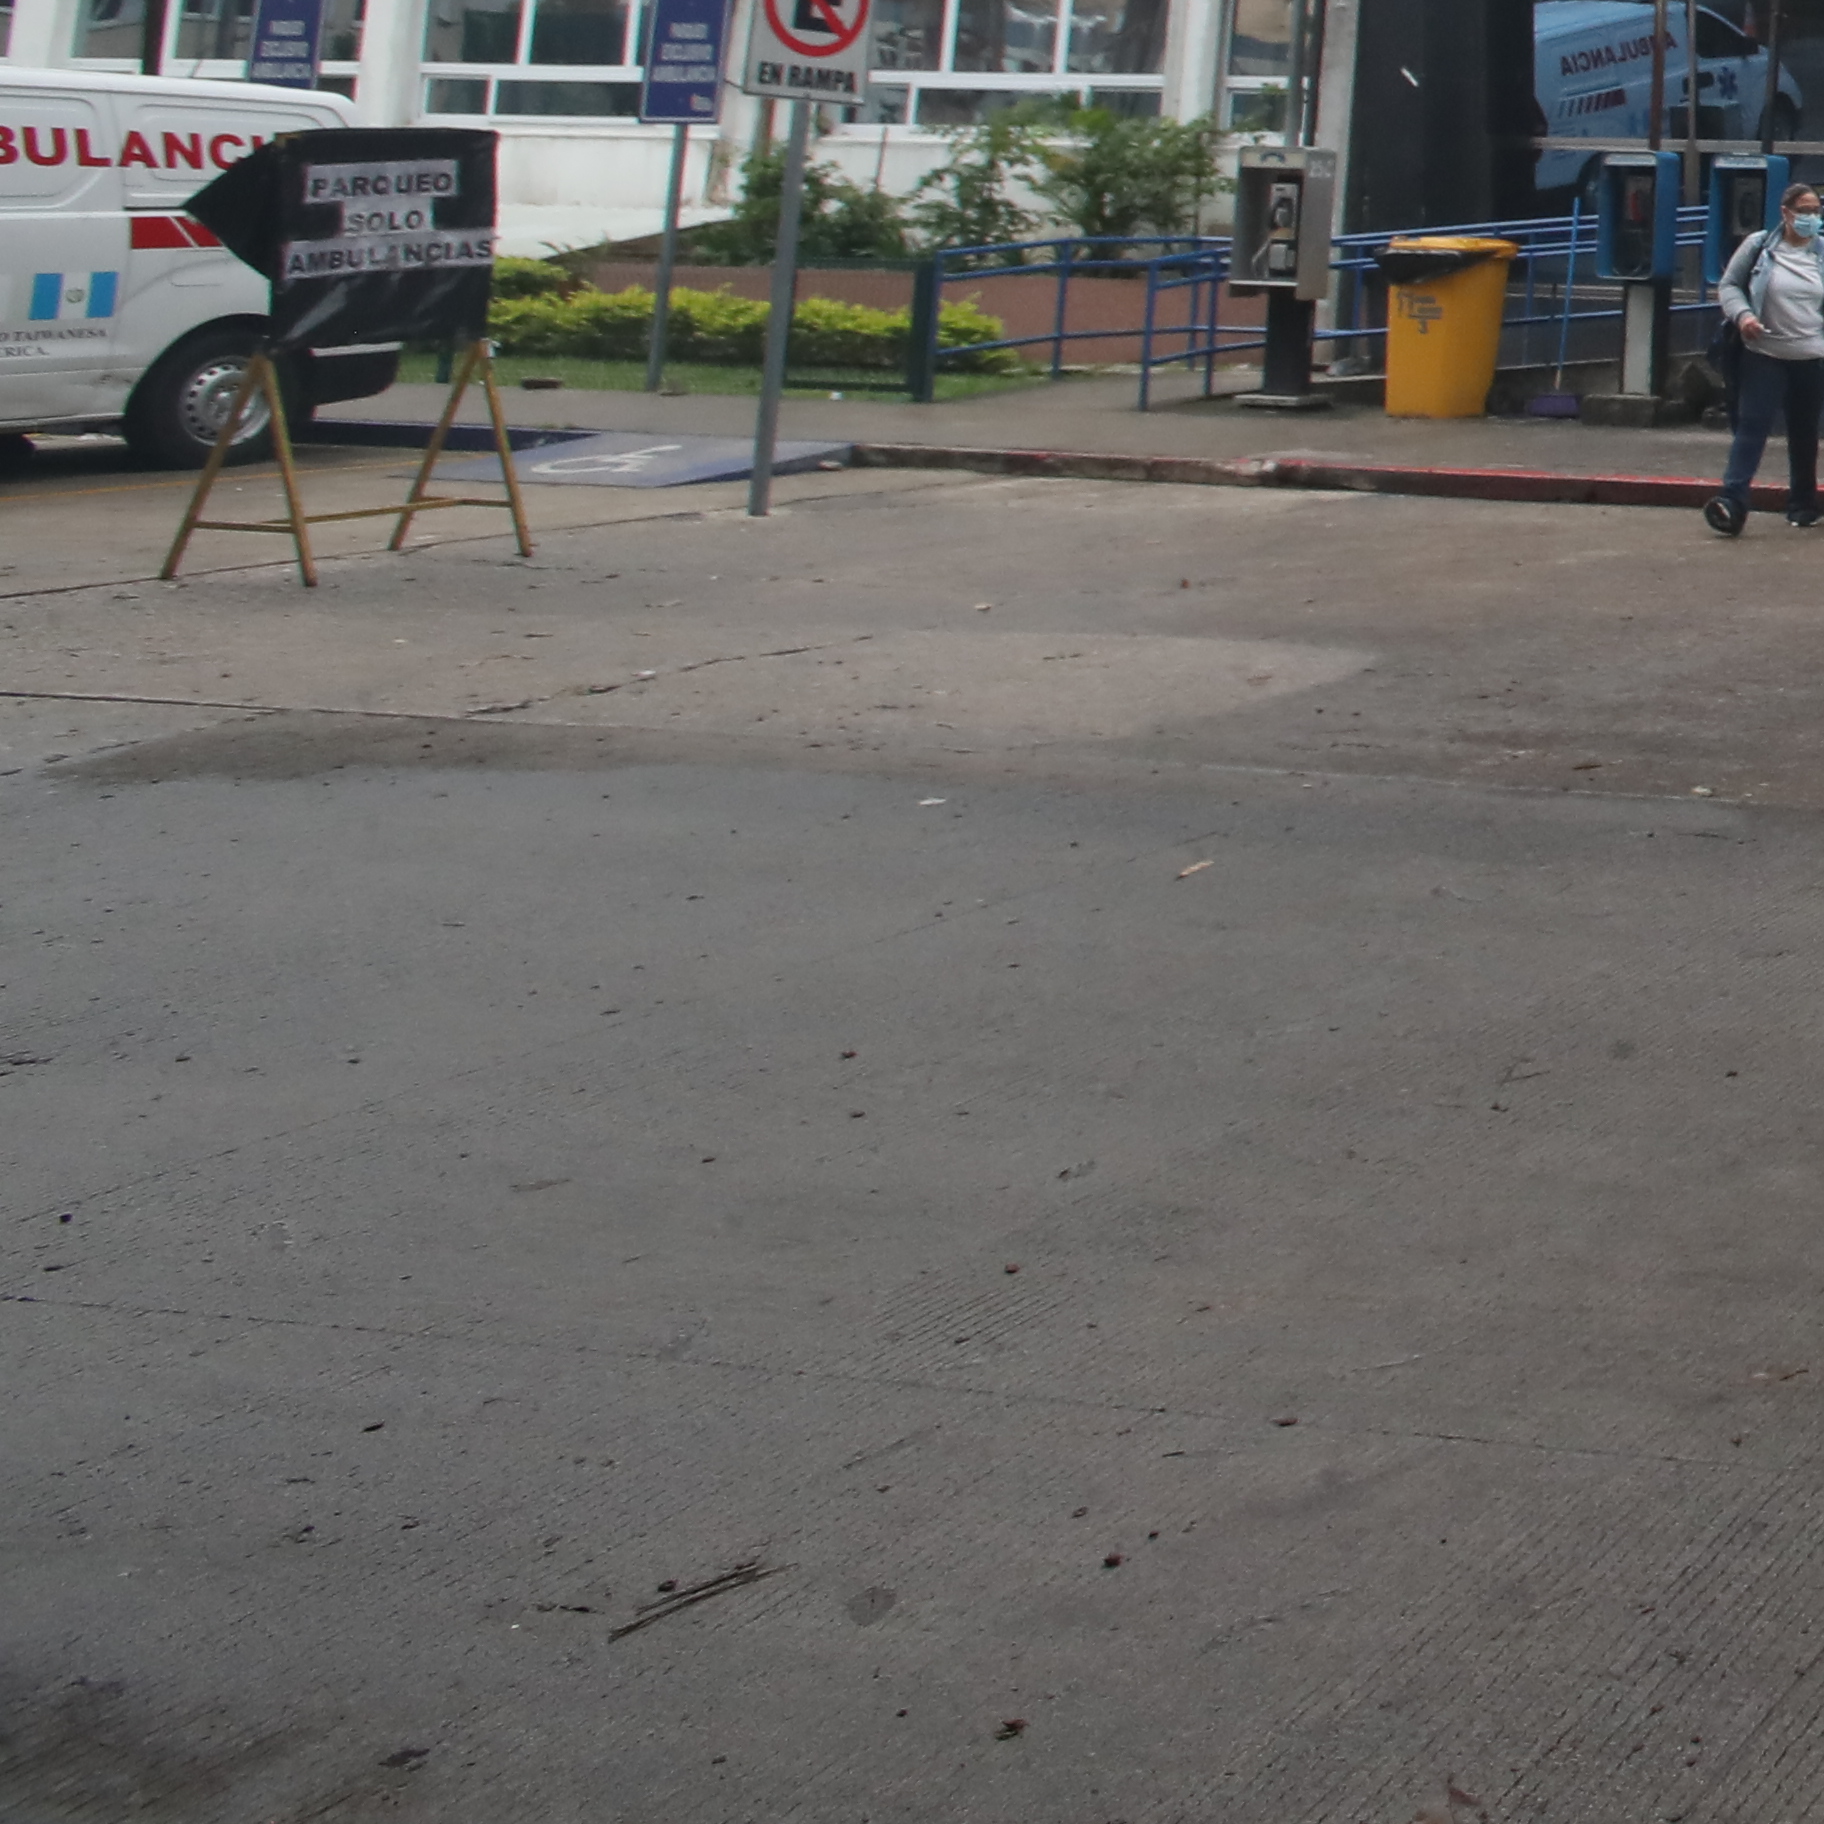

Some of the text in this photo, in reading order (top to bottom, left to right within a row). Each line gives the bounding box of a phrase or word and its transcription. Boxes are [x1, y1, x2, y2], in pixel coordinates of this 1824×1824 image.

[757, 59, 856, 93] EN RAMPA
[310, 172, 452, 198] PARQUEO
[346, 210, 424, 233] SOLO
[289, 238, 493, 273] AMBULANCIAS
